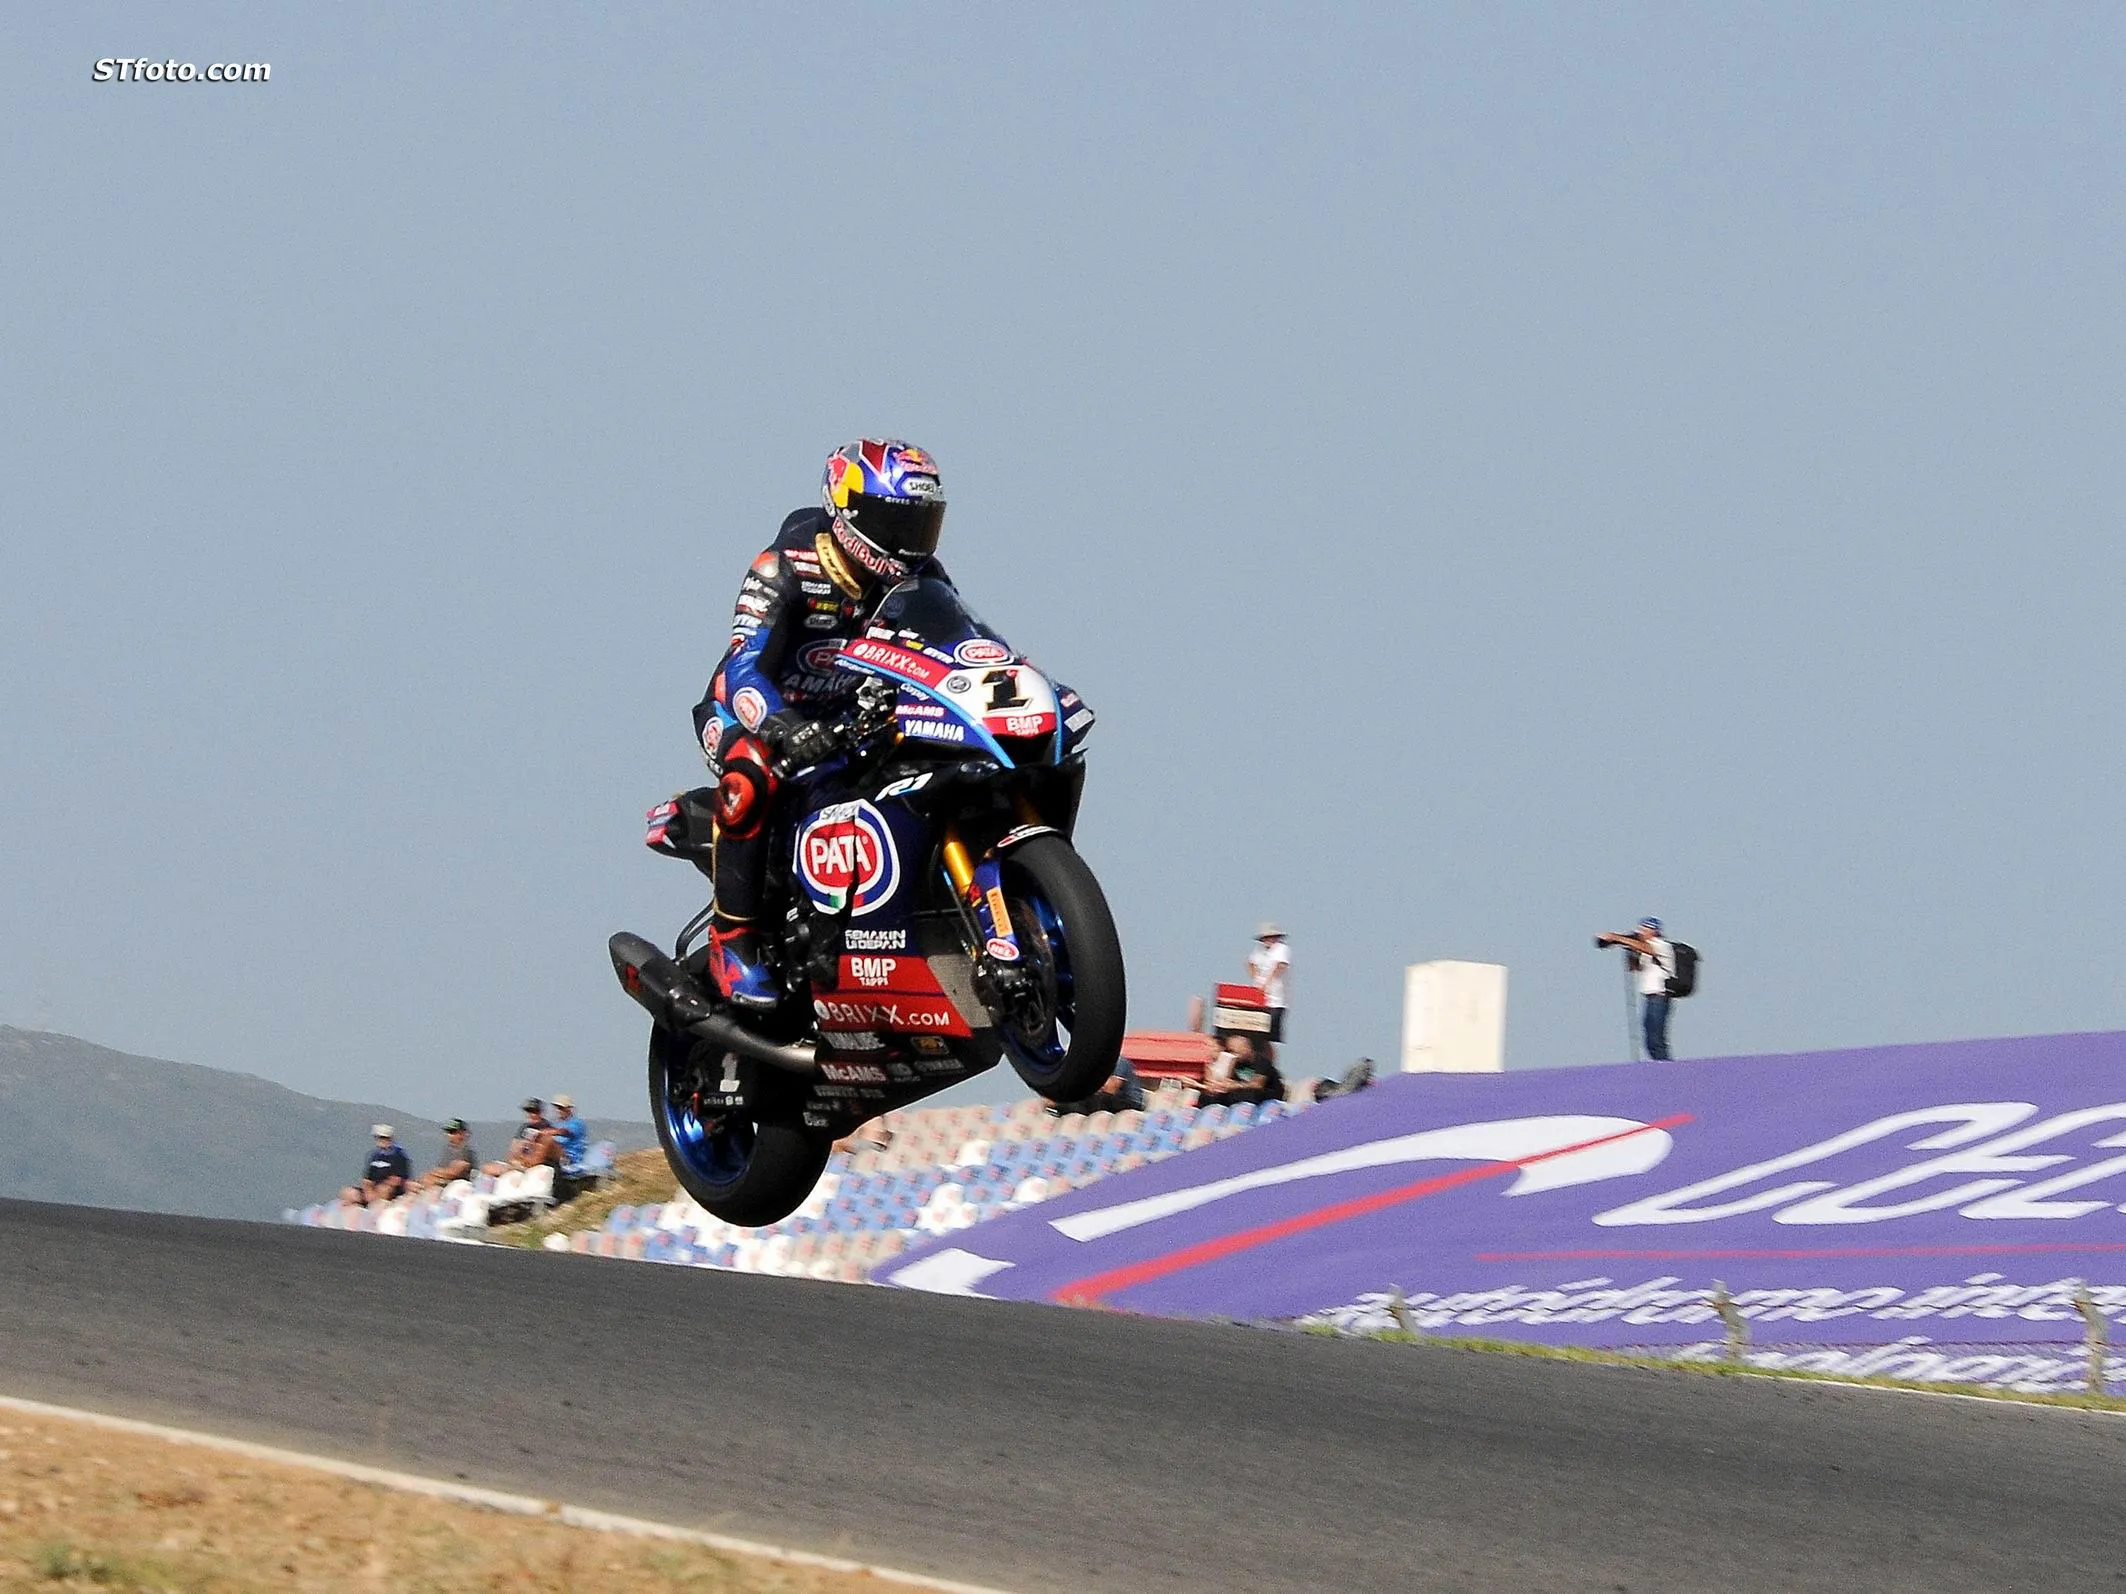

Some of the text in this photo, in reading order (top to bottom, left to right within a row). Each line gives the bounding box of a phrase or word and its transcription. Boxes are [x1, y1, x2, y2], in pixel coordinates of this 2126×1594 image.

[982, 669, 1033, 713] 1
[904, 719, 965, 742] YAMAHA
[1005, 715, 1044, 732] BMP
[810, 834, 872, 875] PATA
[851, 957, 897, 978] BMP
